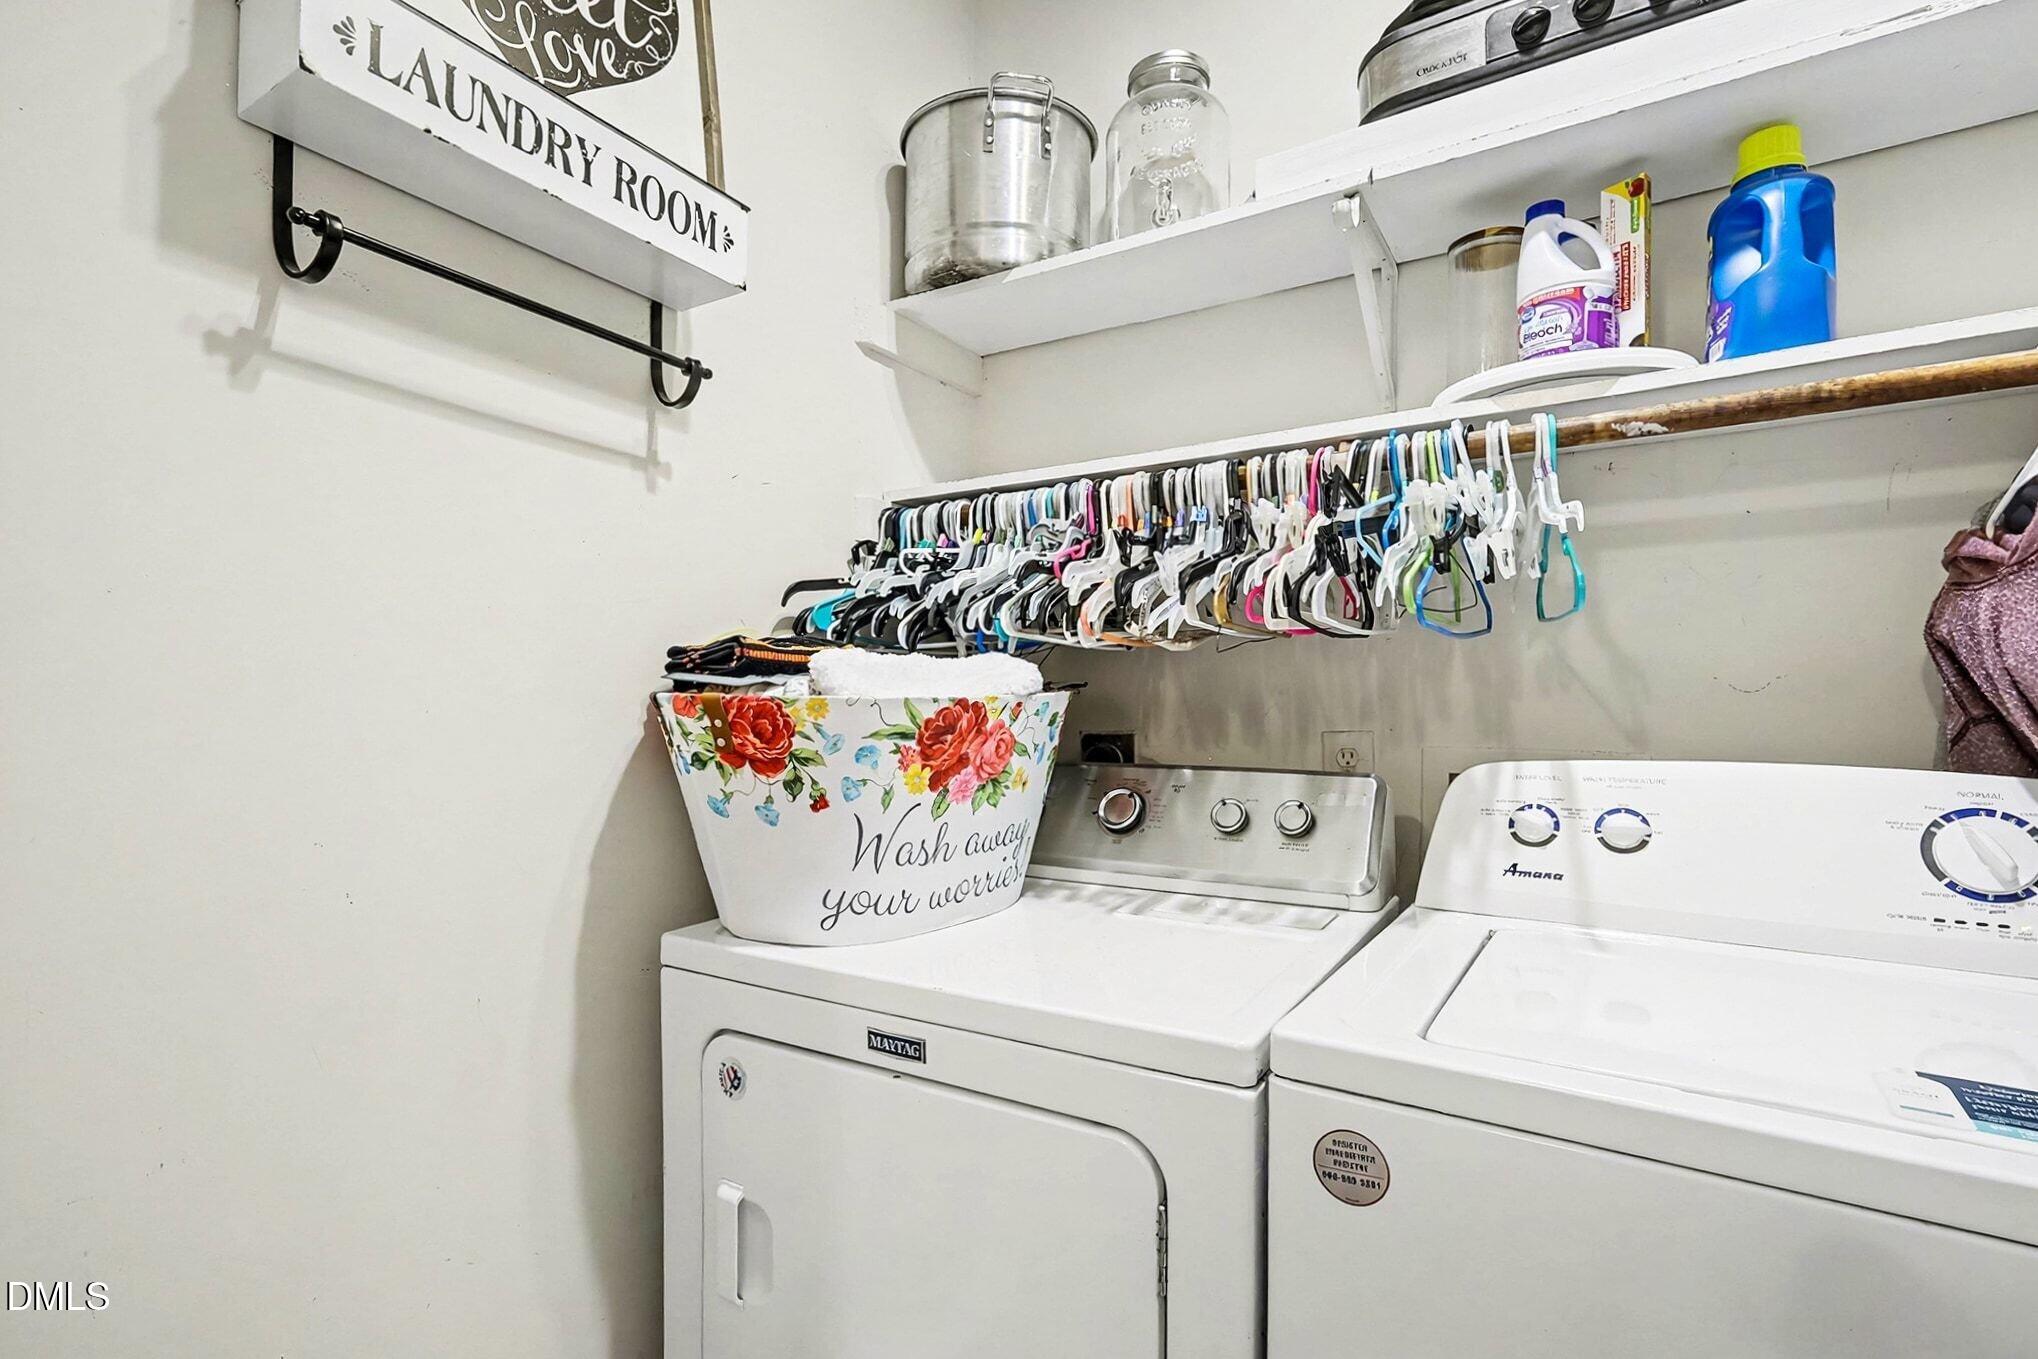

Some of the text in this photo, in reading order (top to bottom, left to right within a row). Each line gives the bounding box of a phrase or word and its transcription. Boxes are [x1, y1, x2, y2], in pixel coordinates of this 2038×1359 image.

[498, 1, 630, 88] Love
[368, 17, 719, 254] LAUNDRY ROOM
[852, 803, 1030, 874] Wash away
[1502, 862, 1564, 881] Amana
[820, 889, 920, 931] your
[869, 1033, 920, 1057] MAYTAG
